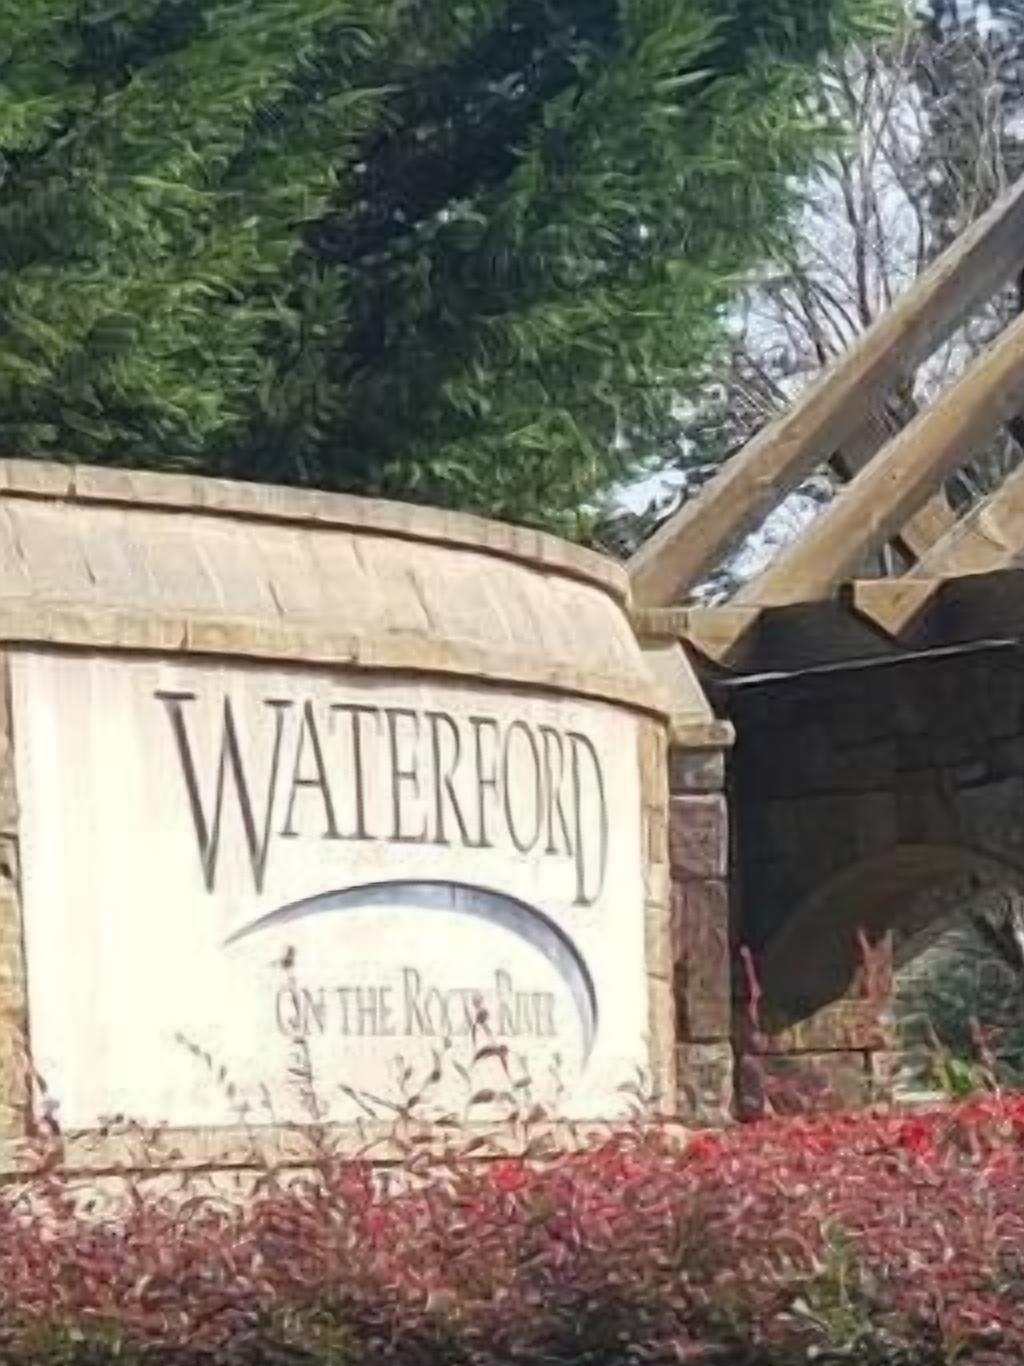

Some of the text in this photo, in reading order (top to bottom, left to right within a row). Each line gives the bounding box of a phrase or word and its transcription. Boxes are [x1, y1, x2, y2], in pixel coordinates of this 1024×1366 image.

[154, 690, 608, 907] WATERFORD
[276, 984, 327, 1037] ON
[337, 984, 397, 1037] THE
